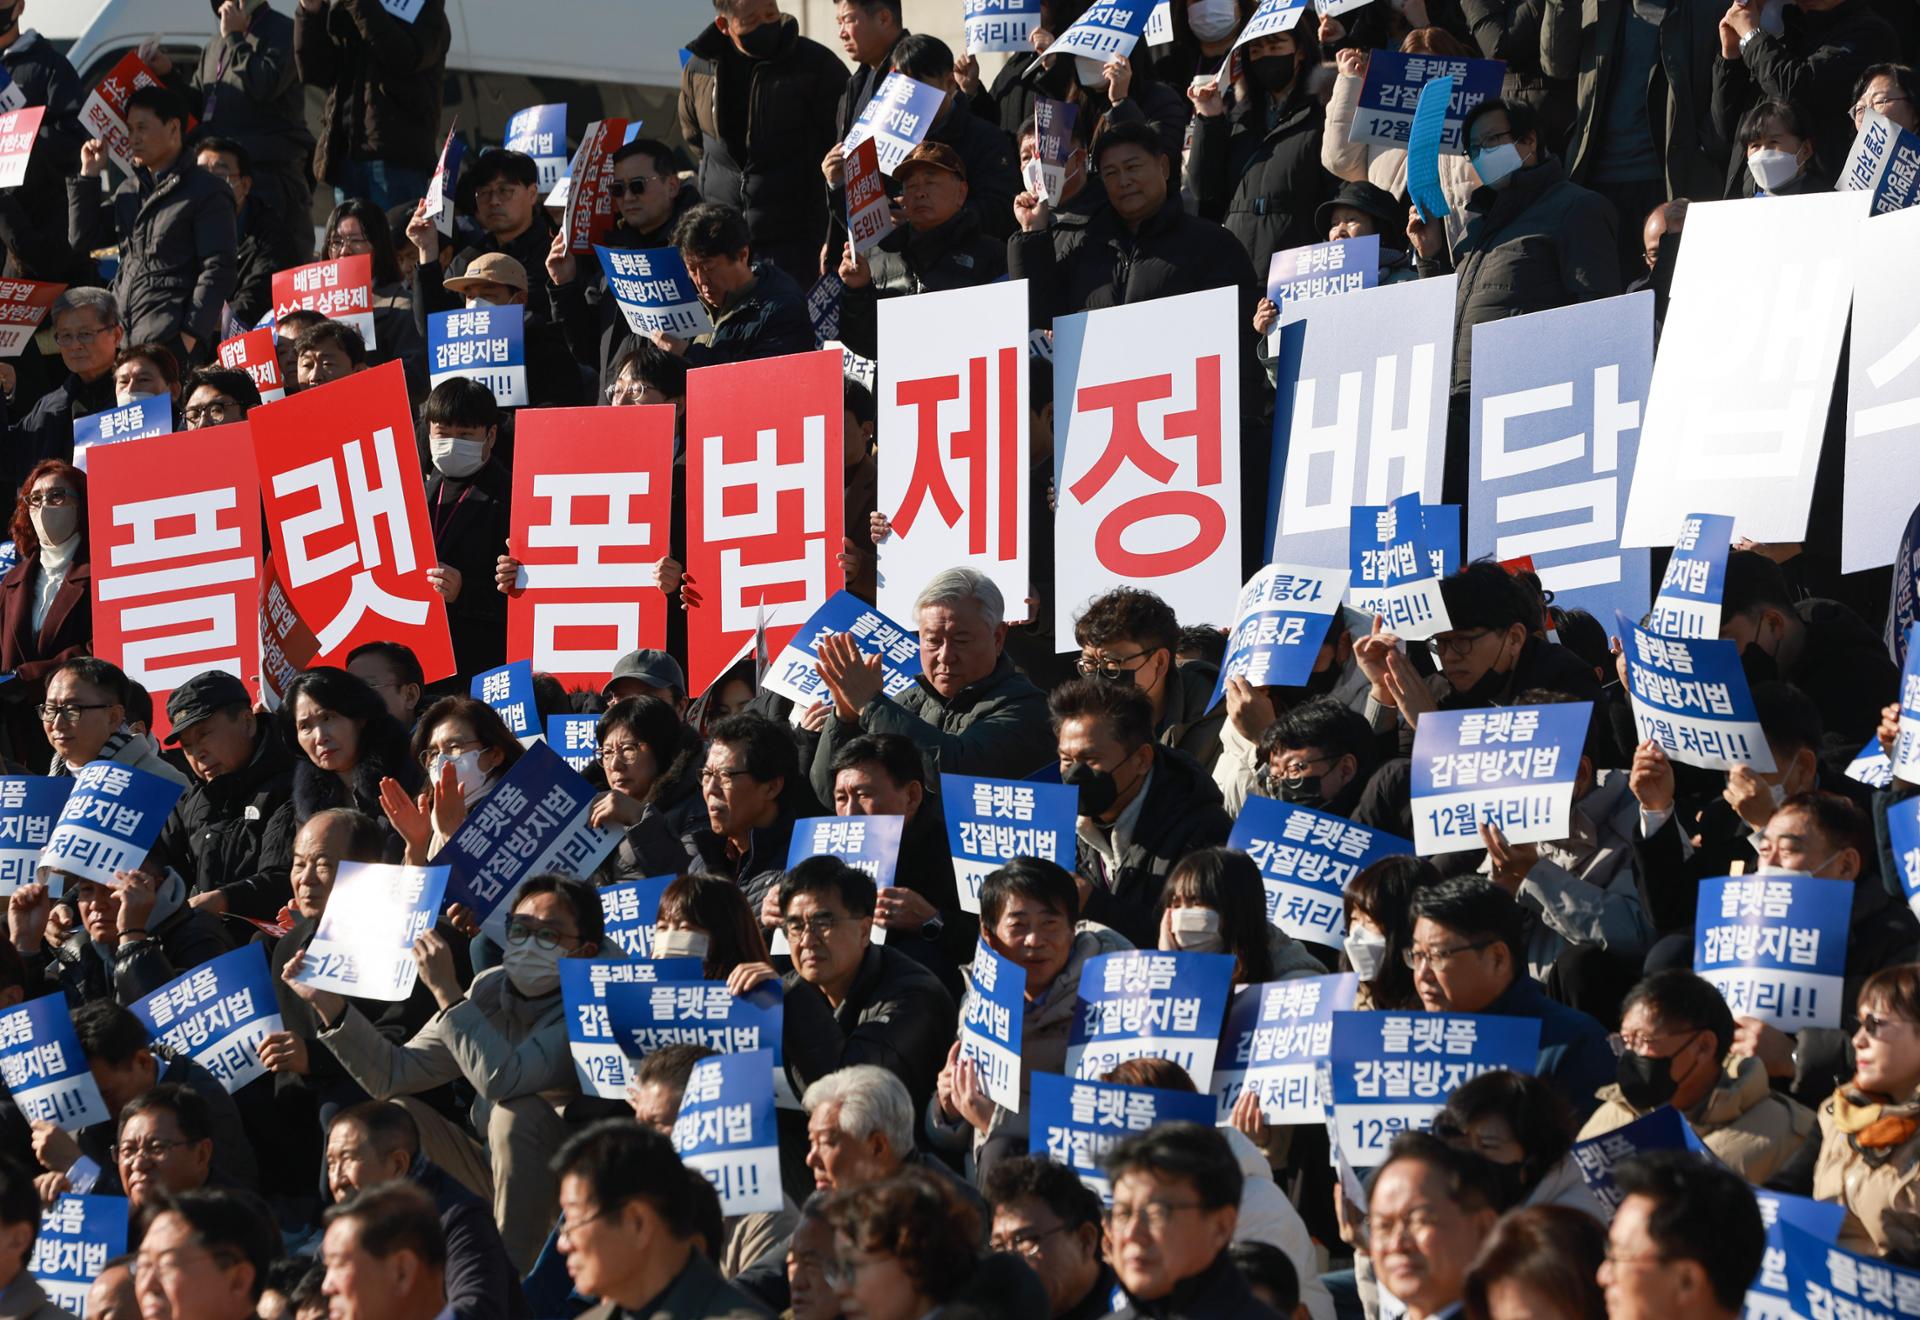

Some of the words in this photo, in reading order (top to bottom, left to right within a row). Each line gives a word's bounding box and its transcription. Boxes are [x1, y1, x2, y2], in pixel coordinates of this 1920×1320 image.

[974, 22, 1028, 45] 처리!!
[1065, 31, 1120, 54] 처리!!
[1404, 58, 1467, 86] 플랫폼
[1379, 84, 1485, 115] 갑질지법
[1863, 120, 1888, 157] 12월
[854, 207, 884, 242] 도입!!
[294, 263, 338, 291] 배달앱
[609, 252, 651, 277] 플랫폼
[1296, 244, 1346, 275] 플랫폼
[317, 285, 368, 314] 상한제
[612, 277, 681, 303] 갑질방지법
[446, 310, 491, 338] 플랫폼
[647, 311, 698, 332] 처리!!
[436, 337, 509, 368] 갑질방지법
[99, 405, 145, 438] 플랫폼
[1282, 343, 1435, 536] 배
[891, 347, 1017, 561] 제
[1069, 354, 1226, 577] 정
[1481, 364, 1640, 592] 달
[272, 426, 430, 657] 랫
[703, 415, 825, 633] 법
[98, 487, 256, 693] 플
[516, 472, 656, 672] 폼
[1271, 573, 1322, 602] 12월
[266, 580, 297, 640] 배달앱
[856, 611, 920, 664] 플랫폼
[1633, 627, 1694, 675] 플랫폼
[482, 670, 511, 704] 플랫폼
[1630, 660, 1735, 716] 갑질방지법
[564, 719, 600, 750] 플랫
[1458, 710, 1540, 747] 플랫폼
[1639, 713, 1677, 752] 12월
[1679, 725, 1752, 761] 처리!!
[1430, 746, 1561, 788] 갑질방지법
[457, 783, 529, 860] 플랫폼
[972, 783, 1036, 821] 플랫폼
[1429, 803, 1477, 838] 12월
[1481, 796, 1553, 833] 처리!!
[468, 784, 578, 903] 갑질방지법
[812, 822, 865, 855] 플랫폼
[959, 821, 1057, 862] 갑질방지법
[1285, 808, 1374, 859] 플랫폼
[48, 832, 126, 875] 처리!!
[1246, 838, 1362, 890] 갑질방지
[1720, 881, 1793, 919] 플랫폼
[1703, 925, 1821, 966] 갑질방지법
[317, 953, 359, 984] 12월
[1103, 955, 1177, 993] 플랫폼
[148, 966, 218, 1028] 플랫폼
[649, 986, 733, 1020] 플랫폼
[1083, 997, 1201, 1036] 갑질방지법
[1262, 982, 1322, 1022] 플랫폼
[1728, 981, 1817, 1018] 처리!!
[150, 987, 256, 1057] 질방지법
[1235, 1020, 1333, 1063] 갑질방지법
[1380, 1015, 1478, 1056] 플랫폼
[585, 1054, 626, 1086] 12월
[1354, 1059, 1508, 1098] 갑질방지
[1070, 1084, 1157, 1132] 플랫폼
